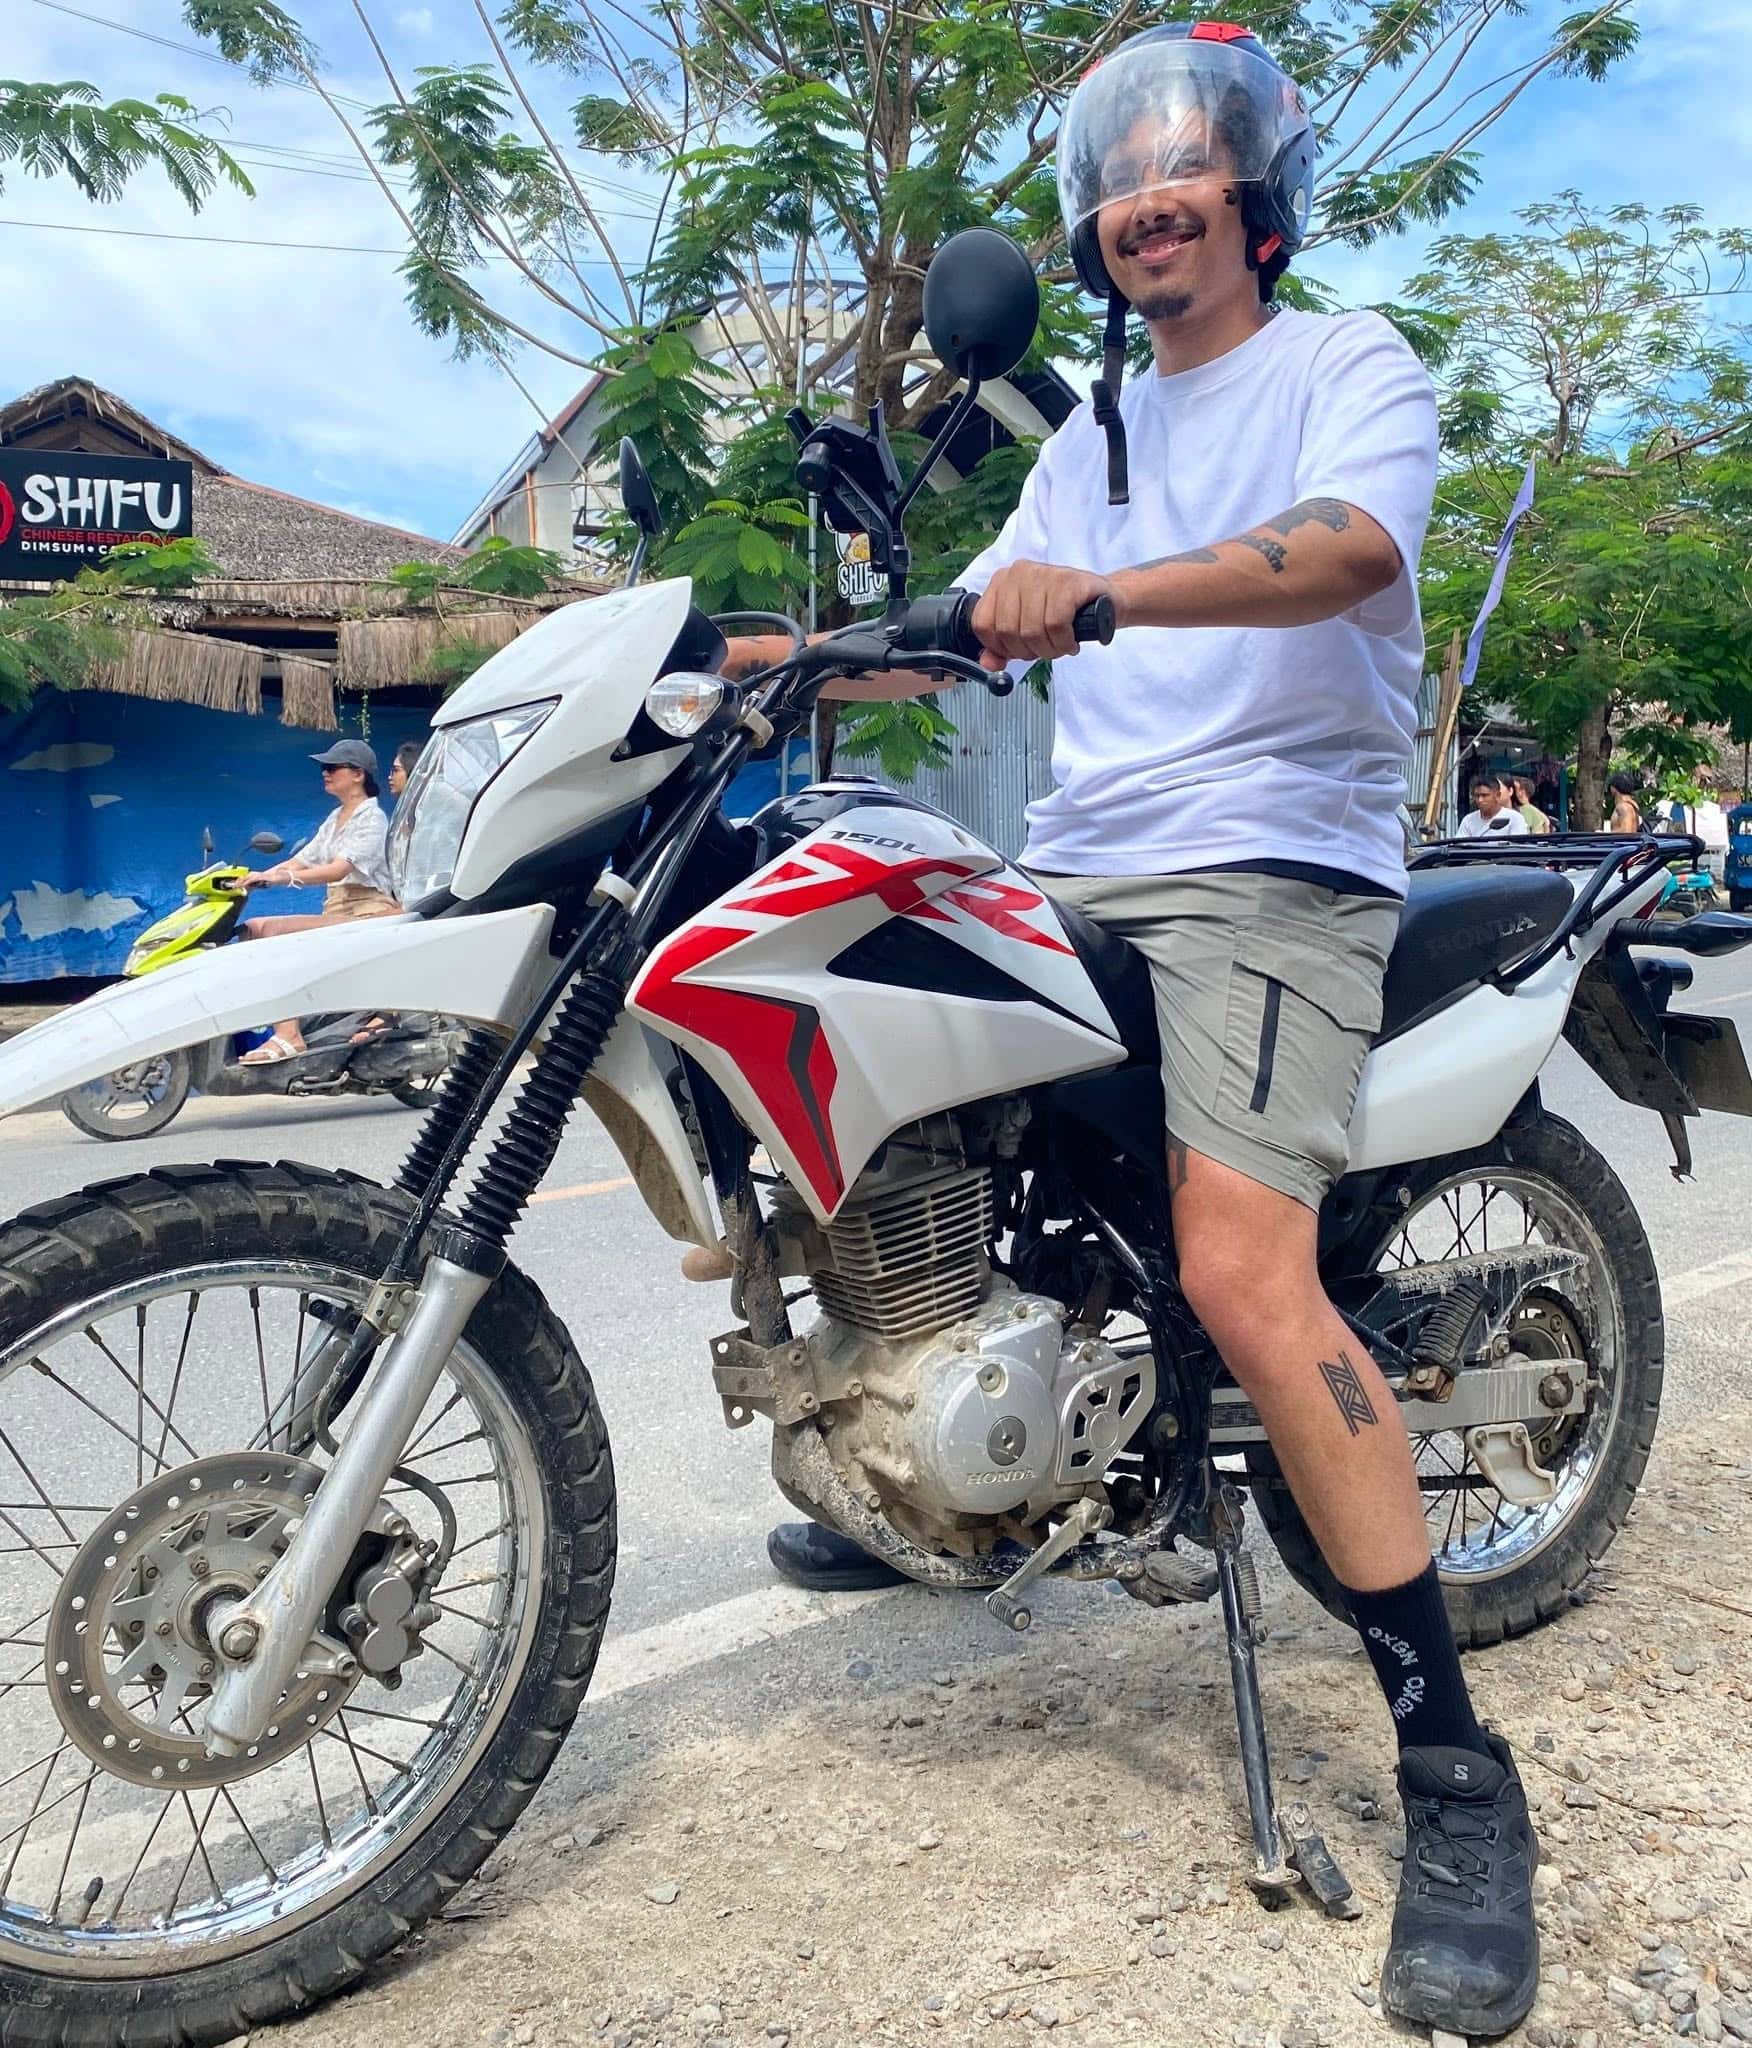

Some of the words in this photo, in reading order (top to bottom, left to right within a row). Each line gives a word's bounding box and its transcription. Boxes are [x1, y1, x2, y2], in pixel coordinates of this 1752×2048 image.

[21, 473, 181, 530] SHIFU
[21, 541, 84, 553] DIMSUM
[22, 528, 84, 542] CHINESE
[840, 561, 883, 596] SHIFU
[830, 830, 927, 855] 150L
[1424, 912, 1538, 959] HONDA
[965, 1467, 1036, 1486] HONDA
[1368, 1626, 1419, 1666] OXGN
[1391, 1676, 1425, 1720] OXGN
